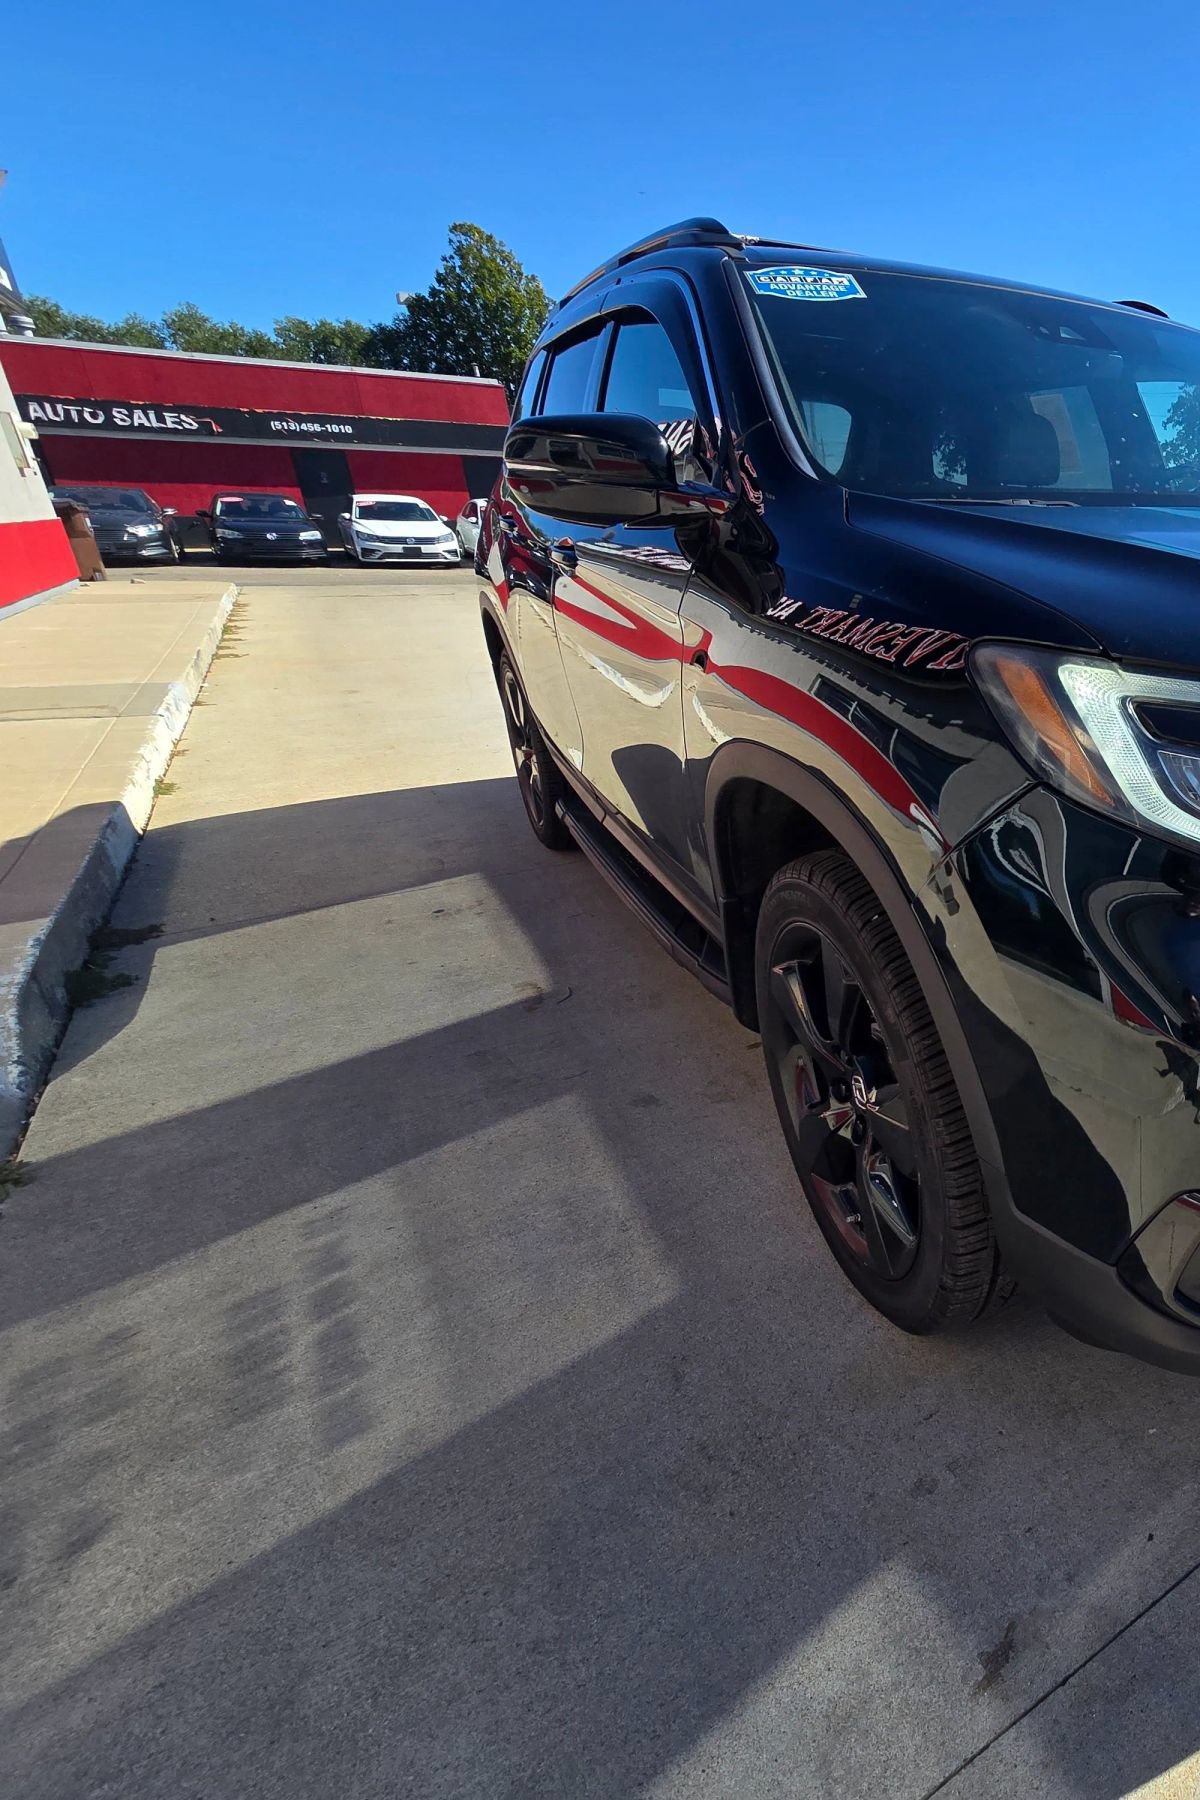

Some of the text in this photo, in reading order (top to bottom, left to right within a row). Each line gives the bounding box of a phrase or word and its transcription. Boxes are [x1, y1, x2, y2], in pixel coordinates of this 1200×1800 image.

[758, 276, 850, 286] CARFAX
[769, 283, 848, 291] ADVANTAGE
[786, 290, 839, 298] DEALER
[28, 401, 199, 430] AUTO SALES
